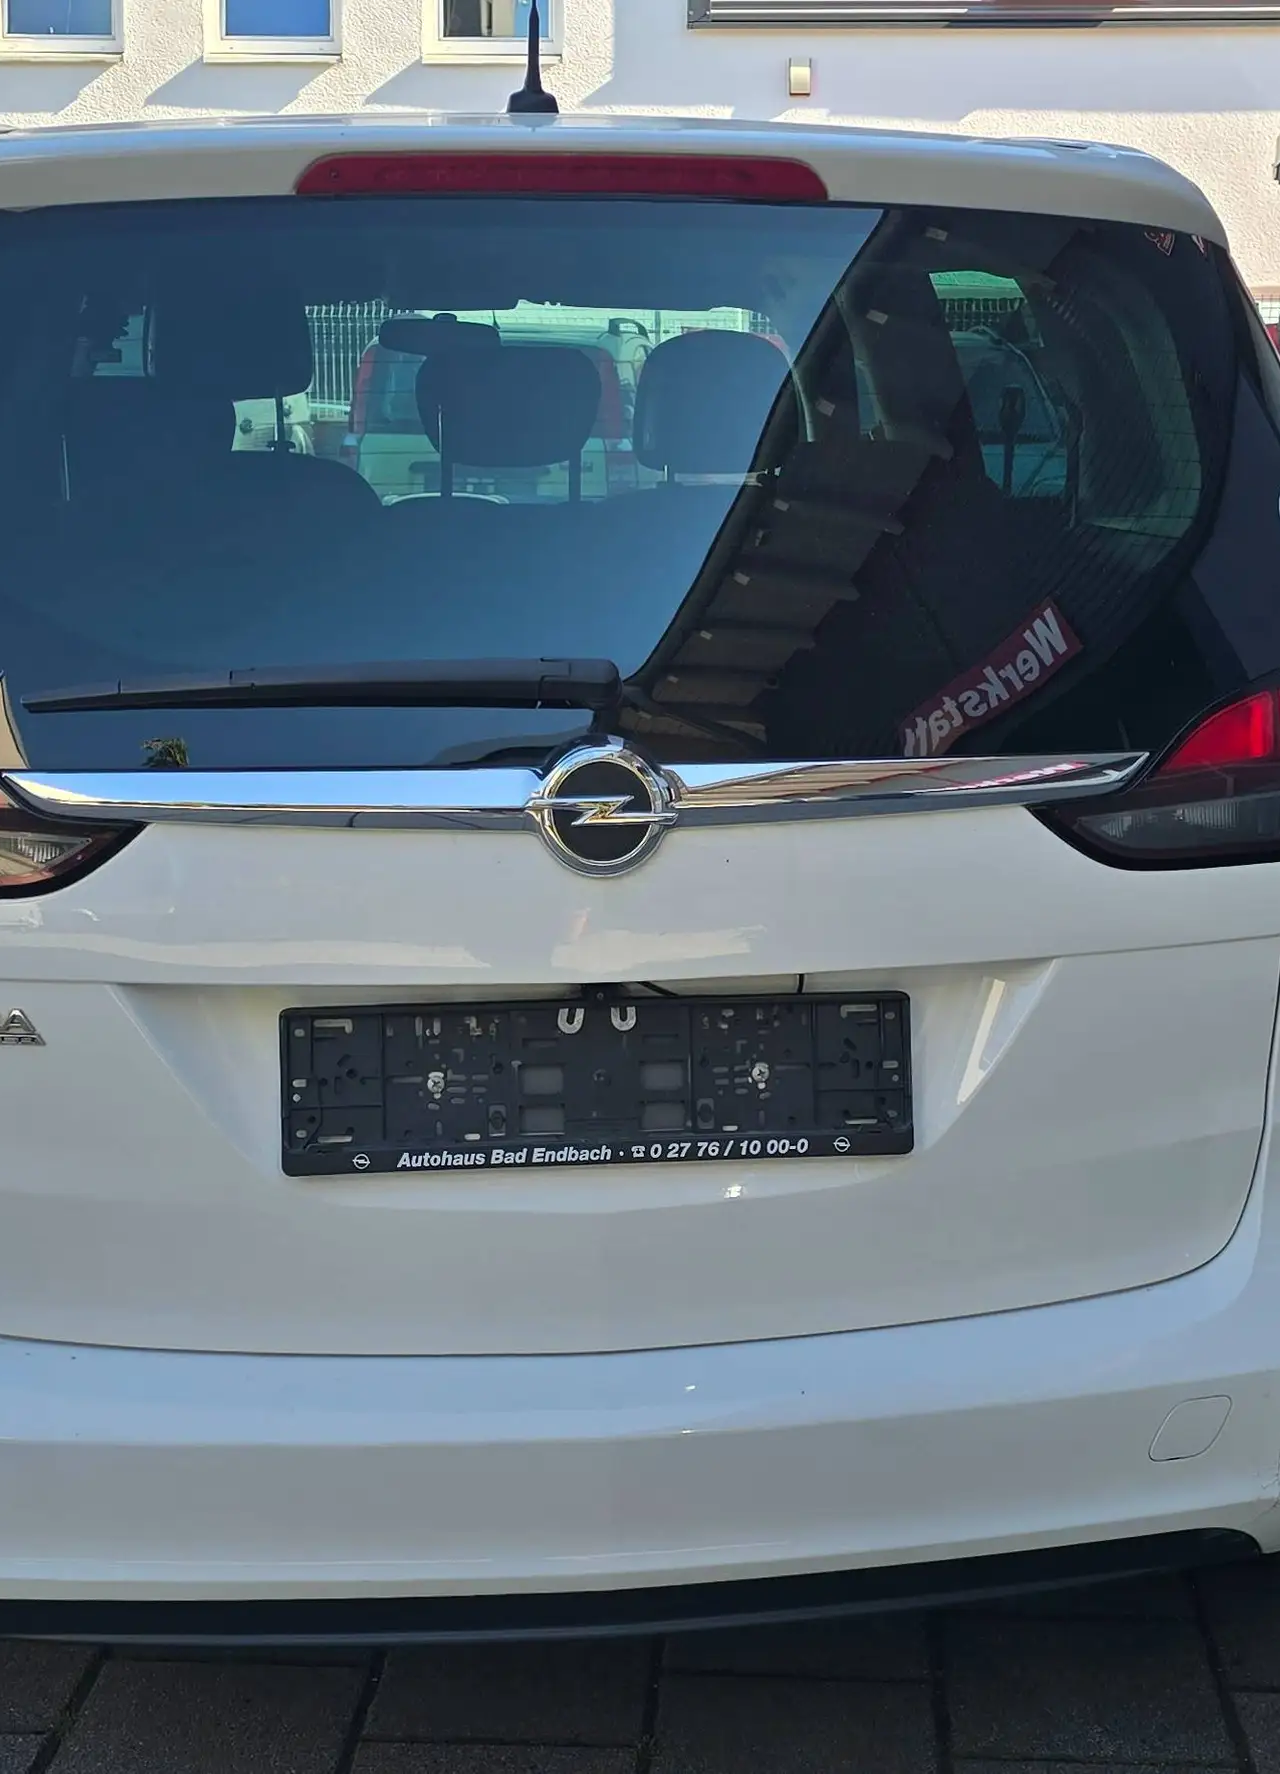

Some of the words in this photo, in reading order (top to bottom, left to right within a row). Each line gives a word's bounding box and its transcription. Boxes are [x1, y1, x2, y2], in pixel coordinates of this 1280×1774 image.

[397, 1151, 486, 1168] Autohaus
[490, 1148, 527, 1165] Bad
[531, 1145, 612, 1163] Endbach
[649, 1143, 662, 1158] 0
[666, 1142, 692, 1157] 27
[696, 1141, 720, 1157] 76
[723, 1140, 735, 1156] /
[739, 1140, 762, 1155] 10
[766, 1138, 809, 1154] 00-0
